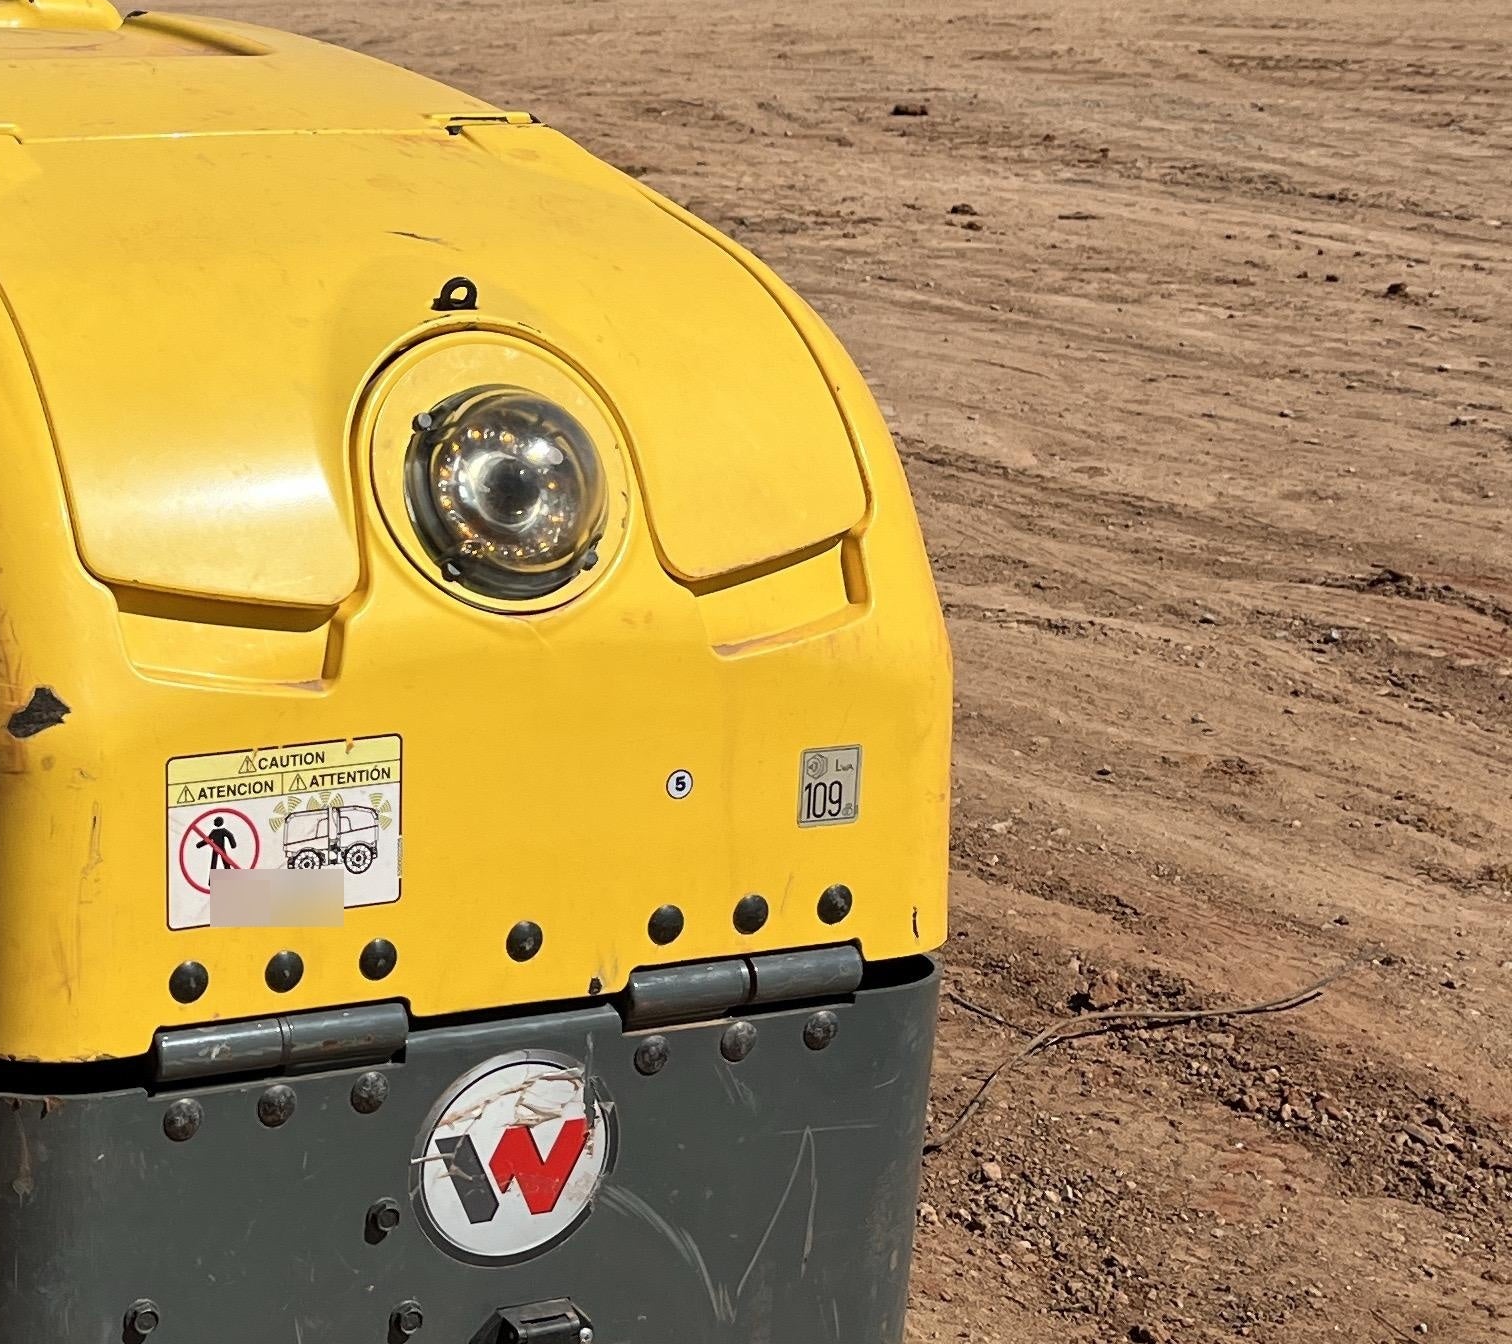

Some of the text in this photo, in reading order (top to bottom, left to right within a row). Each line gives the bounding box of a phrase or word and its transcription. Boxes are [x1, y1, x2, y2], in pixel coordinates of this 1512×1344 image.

[257, 750, 326, 771] CAUTION
[309, 765, 392, 788] ATTENTIÓN
[674, 774, 687, 792] 5
[197, 779, 275, 801] ATENCION
[804, 780, 843, 819] 109
